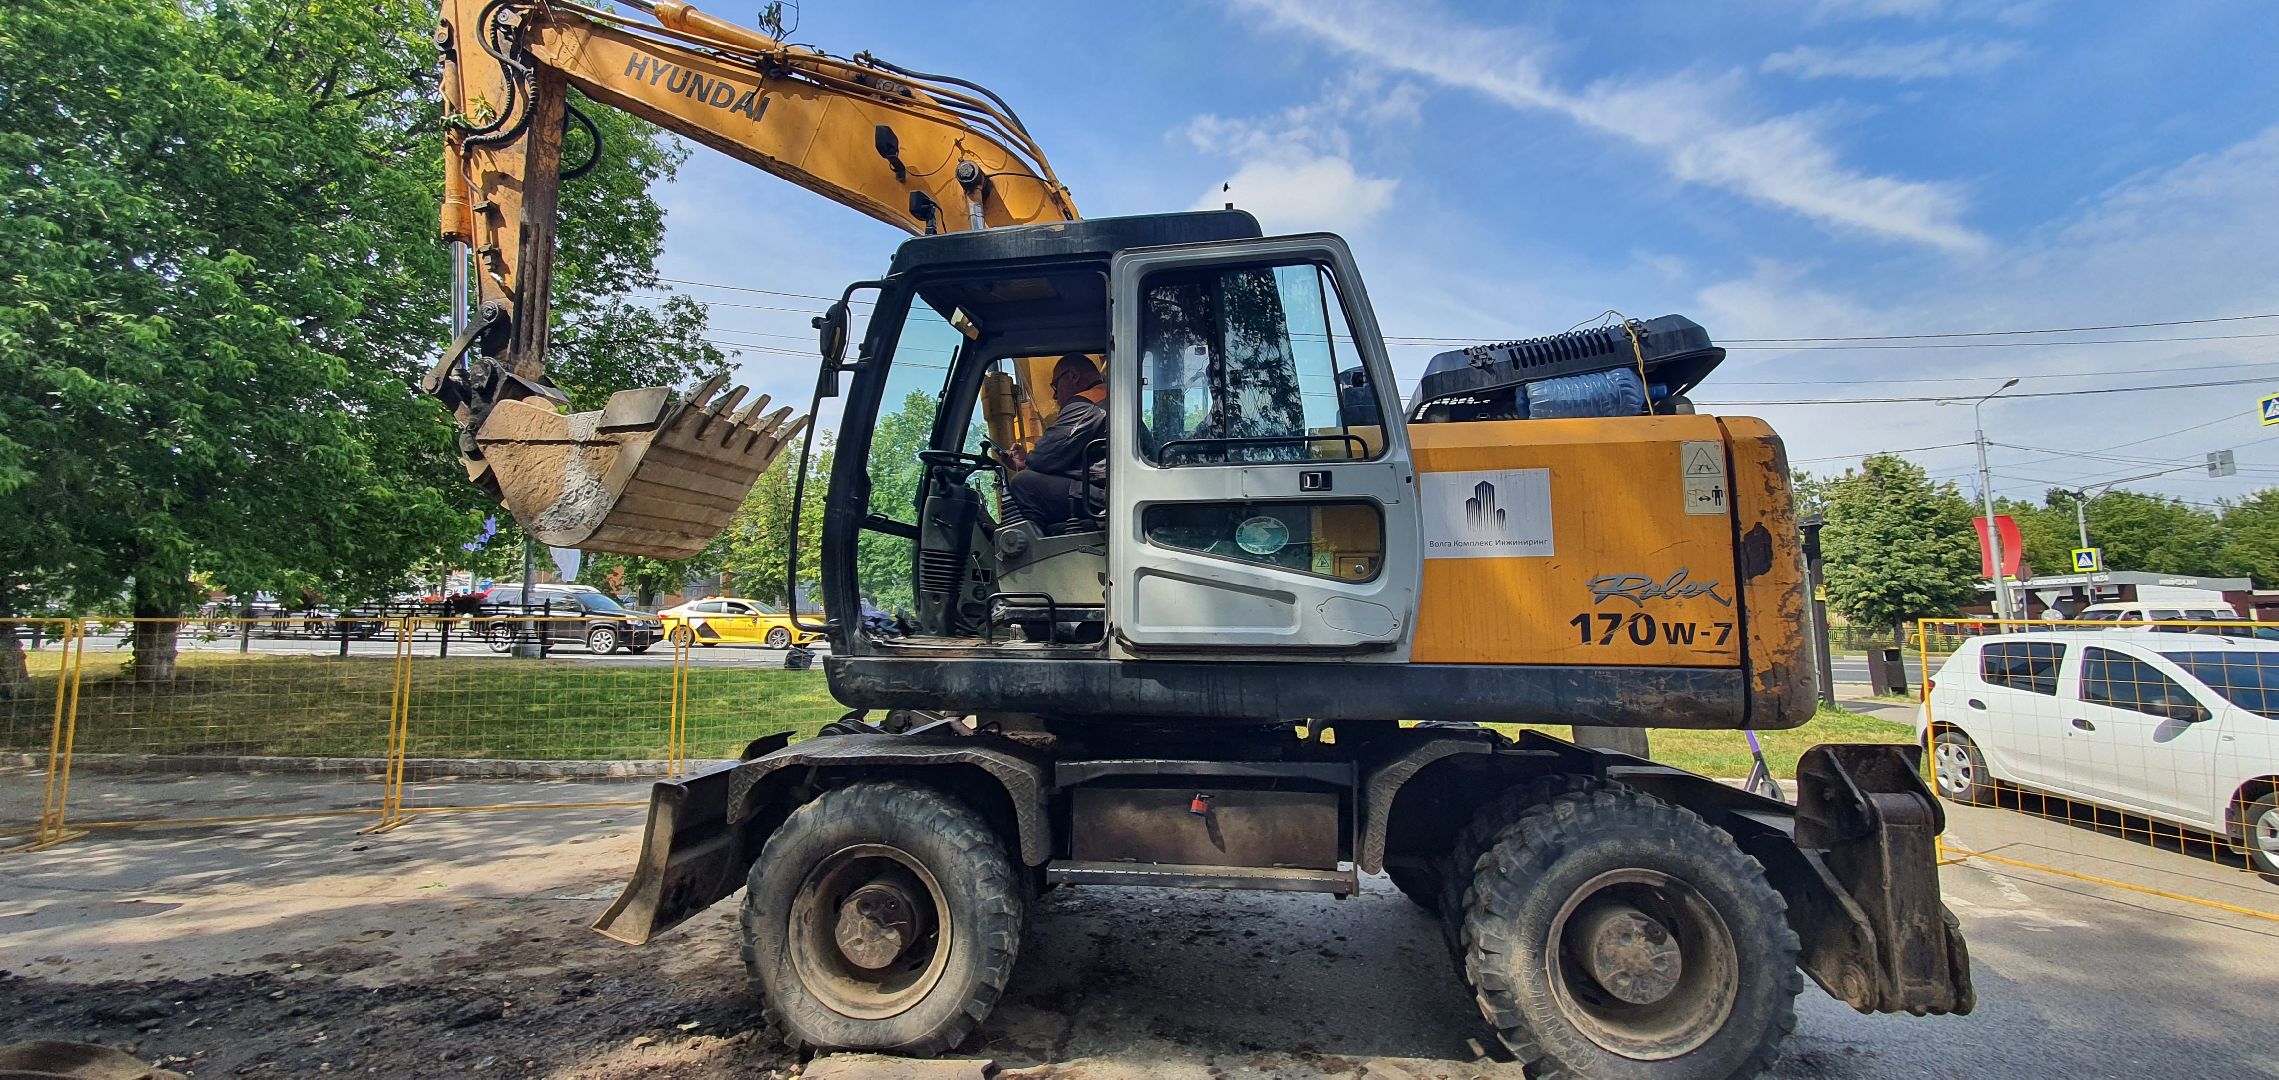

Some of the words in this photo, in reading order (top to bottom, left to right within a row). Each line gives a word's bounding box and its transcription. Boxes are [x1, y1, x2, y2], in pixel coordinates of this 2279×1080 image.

[624, 52, 771, 122] HYUNDAI
[1429, 540, 1452, 548] Волга
[1453, 540, 1493, 548] Комплекс
[1495, 539, 1549, 547] Инжиниринг
[1586, 567, 1732, 608] Robex
